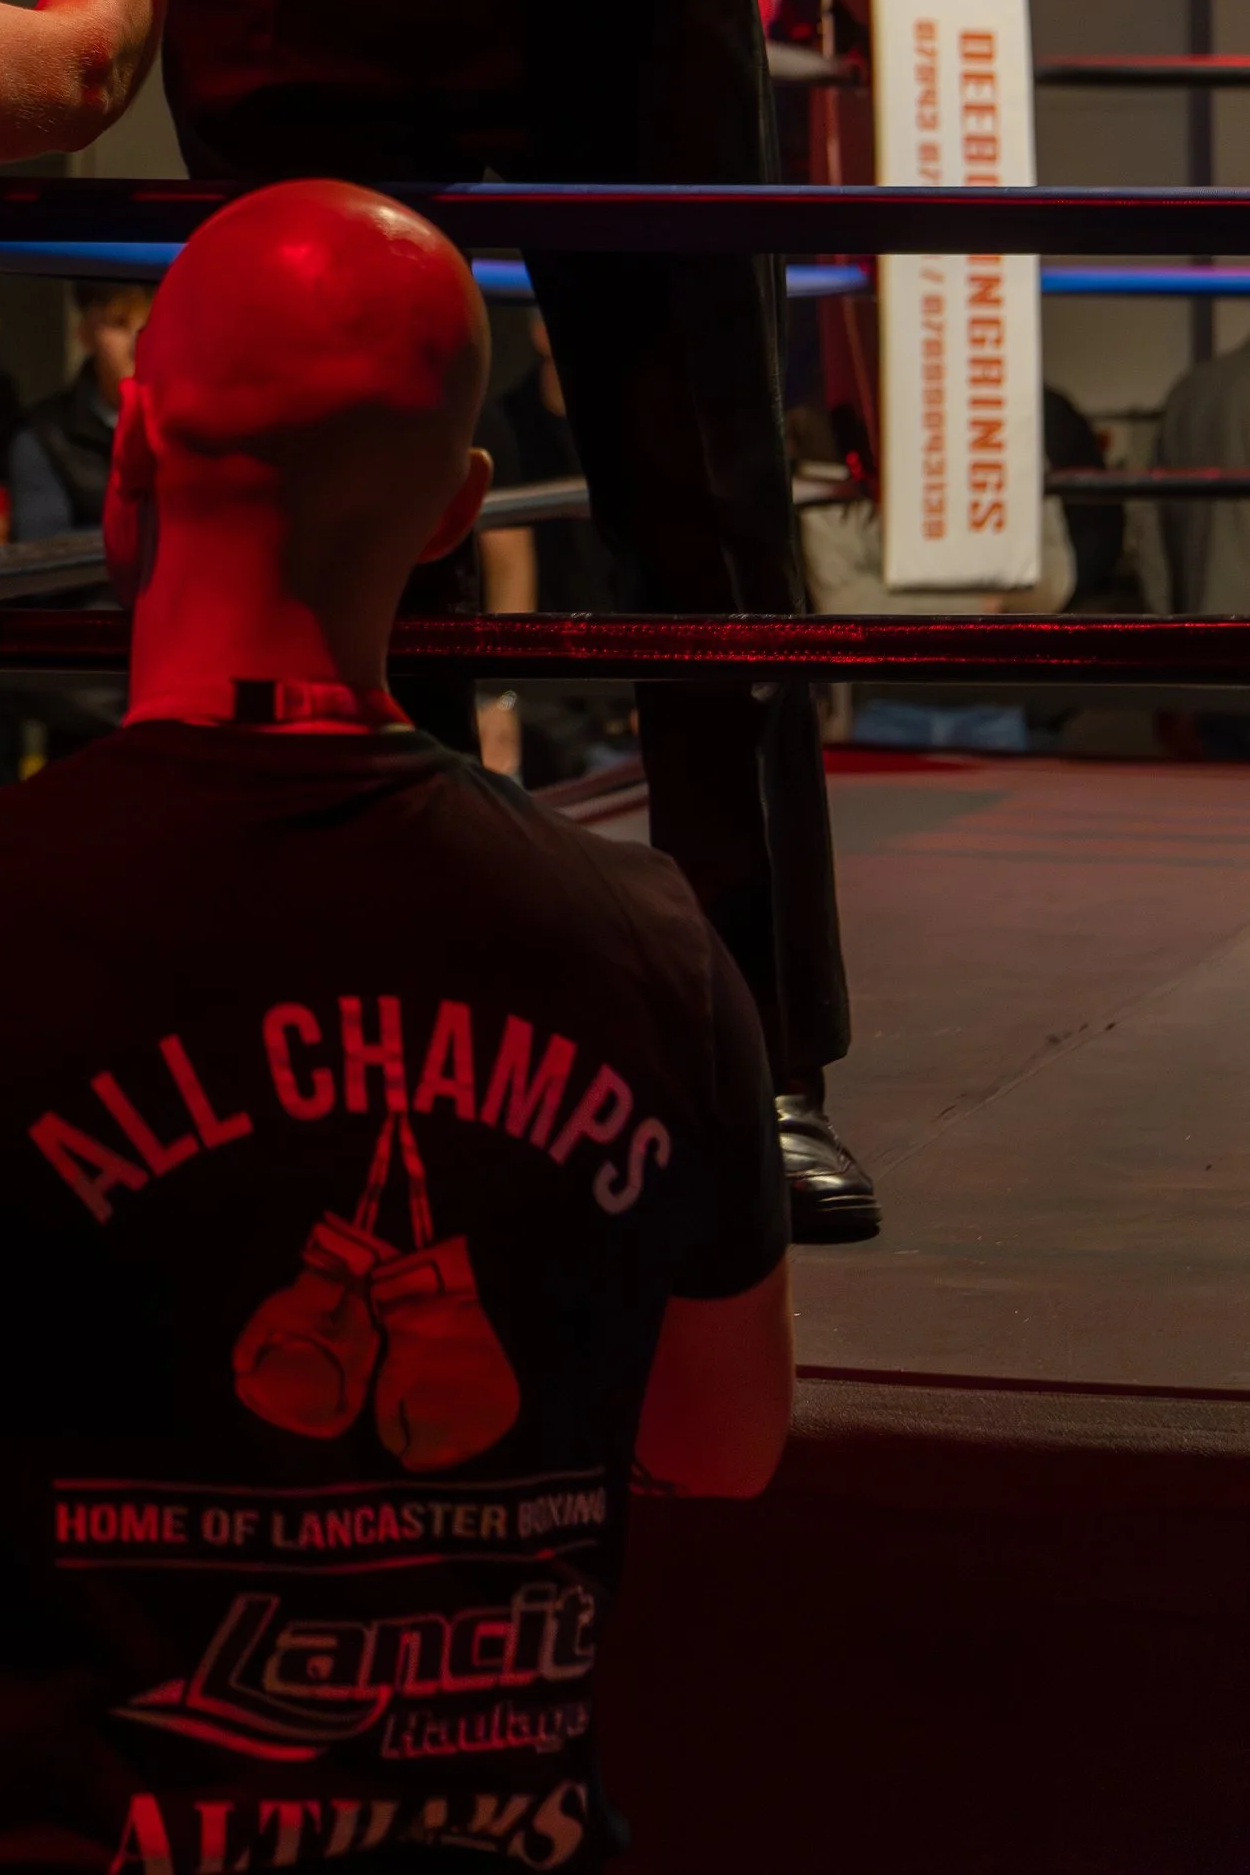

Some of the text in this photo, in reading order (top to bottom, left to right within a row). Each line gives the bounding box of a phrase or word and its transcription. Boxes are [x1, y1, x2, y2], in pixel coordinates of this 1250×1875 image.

[27, 993, 672, 1224] ALL CHAMPS
[55, 1485, 607, 1551] HOME OF LANCASTER BOXING
